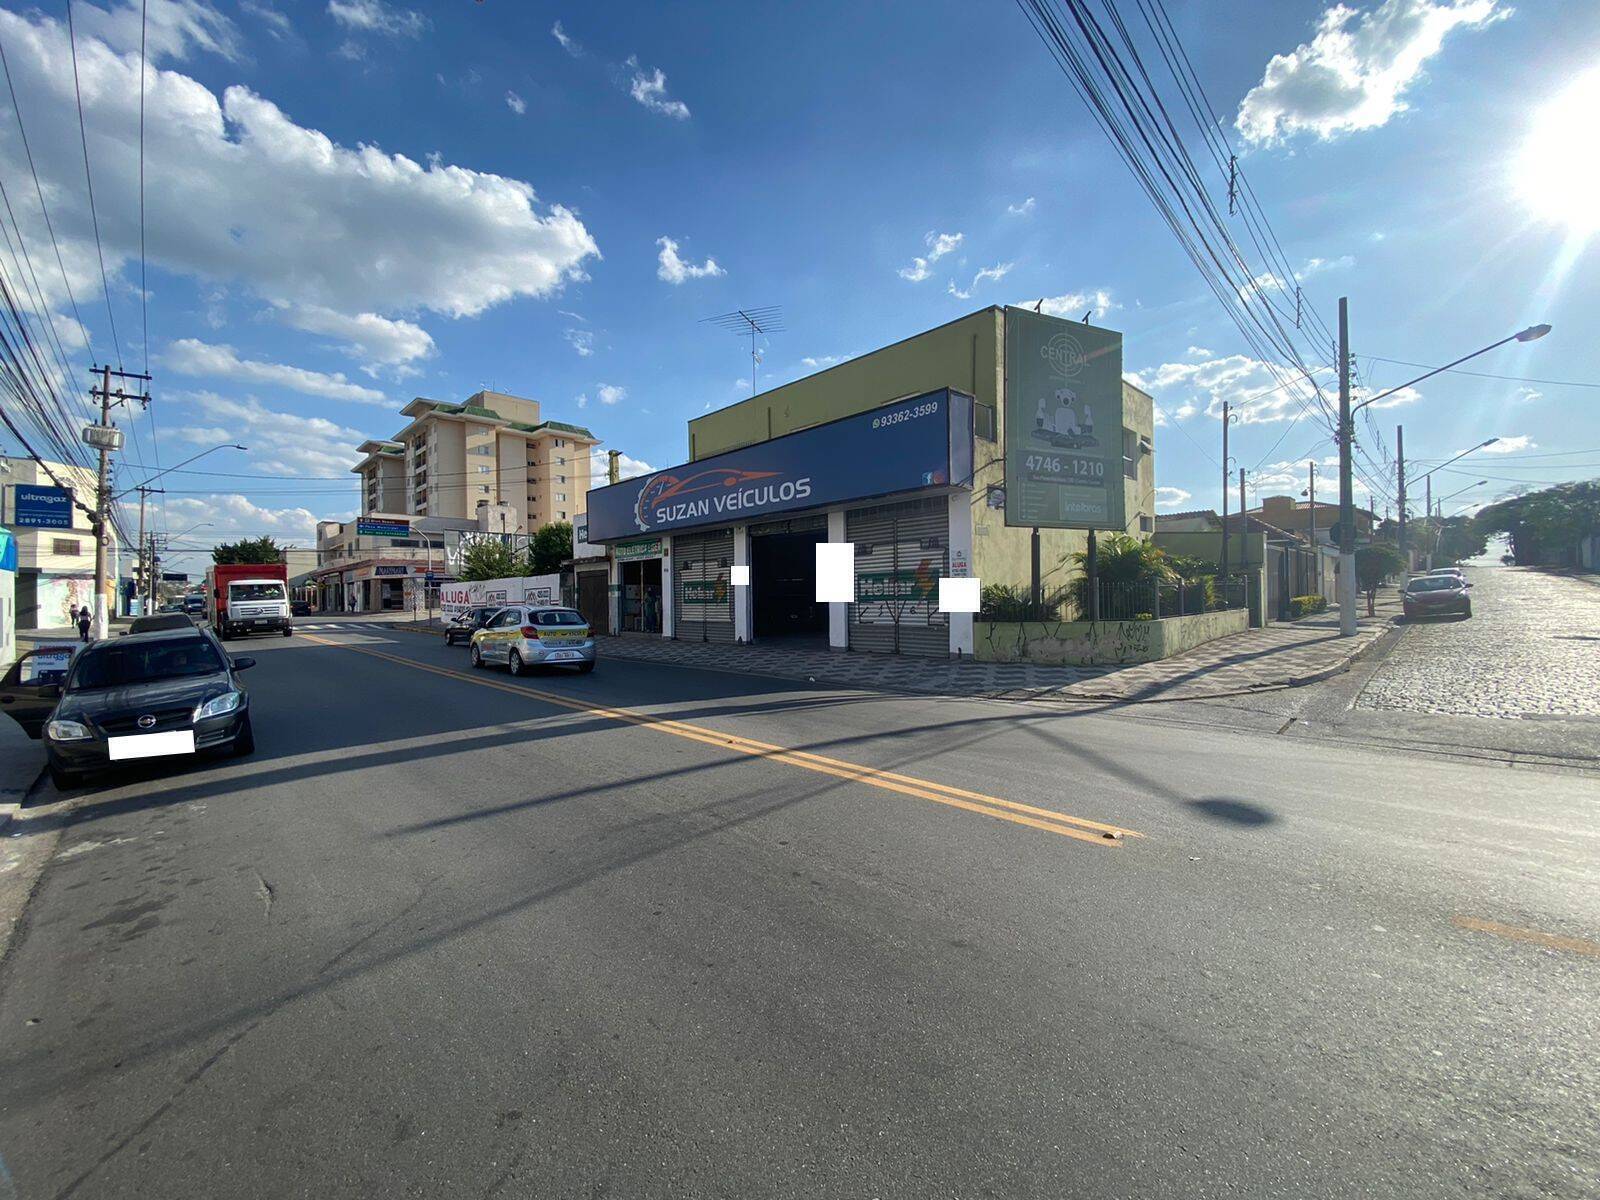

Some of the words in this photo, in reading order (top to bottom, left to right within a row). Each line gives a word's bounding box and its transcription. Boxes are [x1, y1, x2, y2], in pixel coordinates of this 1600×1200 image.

[1040, 345, 1091, 367] CENTRAL
[880, 401, 938, 428] 93362-3599
[1025, 455, 1061, 473] 4746
[1072, 459, 1104, 477] 1210
[20, 493, 67, 504] ultragaz
[656, 498, 710, 524] SUZAN
[715, 477, 812, 514] VEÍCULOS
[19, 517, 69, 525] 2891-3005
[440, 590, 470, 604] ALUGA
